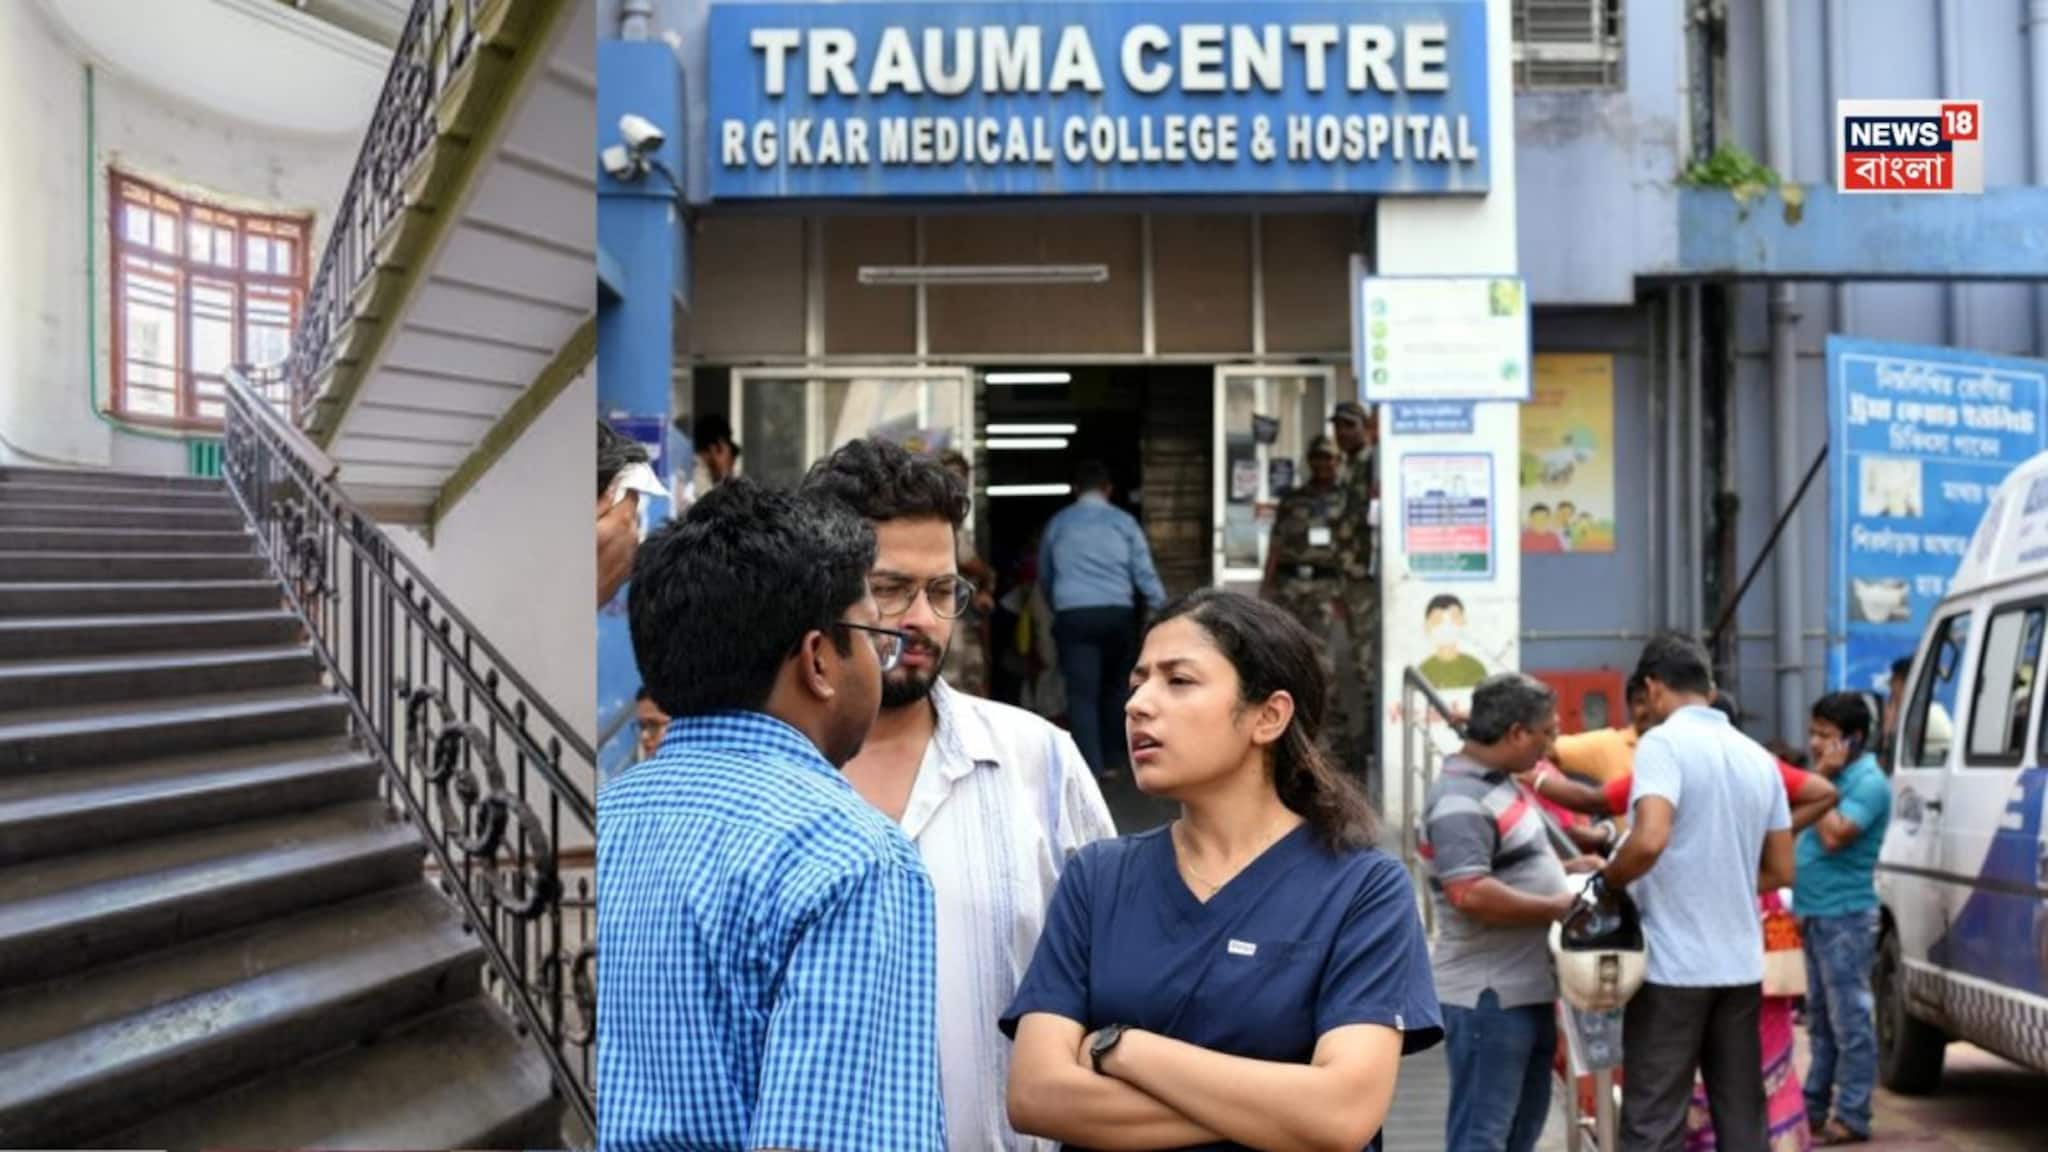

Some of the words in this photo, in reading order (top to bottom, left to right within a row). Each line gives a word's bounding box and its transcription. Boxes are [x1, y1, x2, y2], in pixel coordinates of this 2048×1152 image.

[750, 25, 1104, 96] TRAUMA
[1120, 23, 1450, 93] CENTRE
[722, 119, 747, 165] R
[751, 119, 779, 167] G
[787, 118, 870, 165] KAR
[879, 116, 1055, 163] MEDICAL
[1062, 114, 1240, 162] COLLEGE
[1249, 115, 1277, 161] &
[1286, 114, 1479, 162] HOSPITAL
